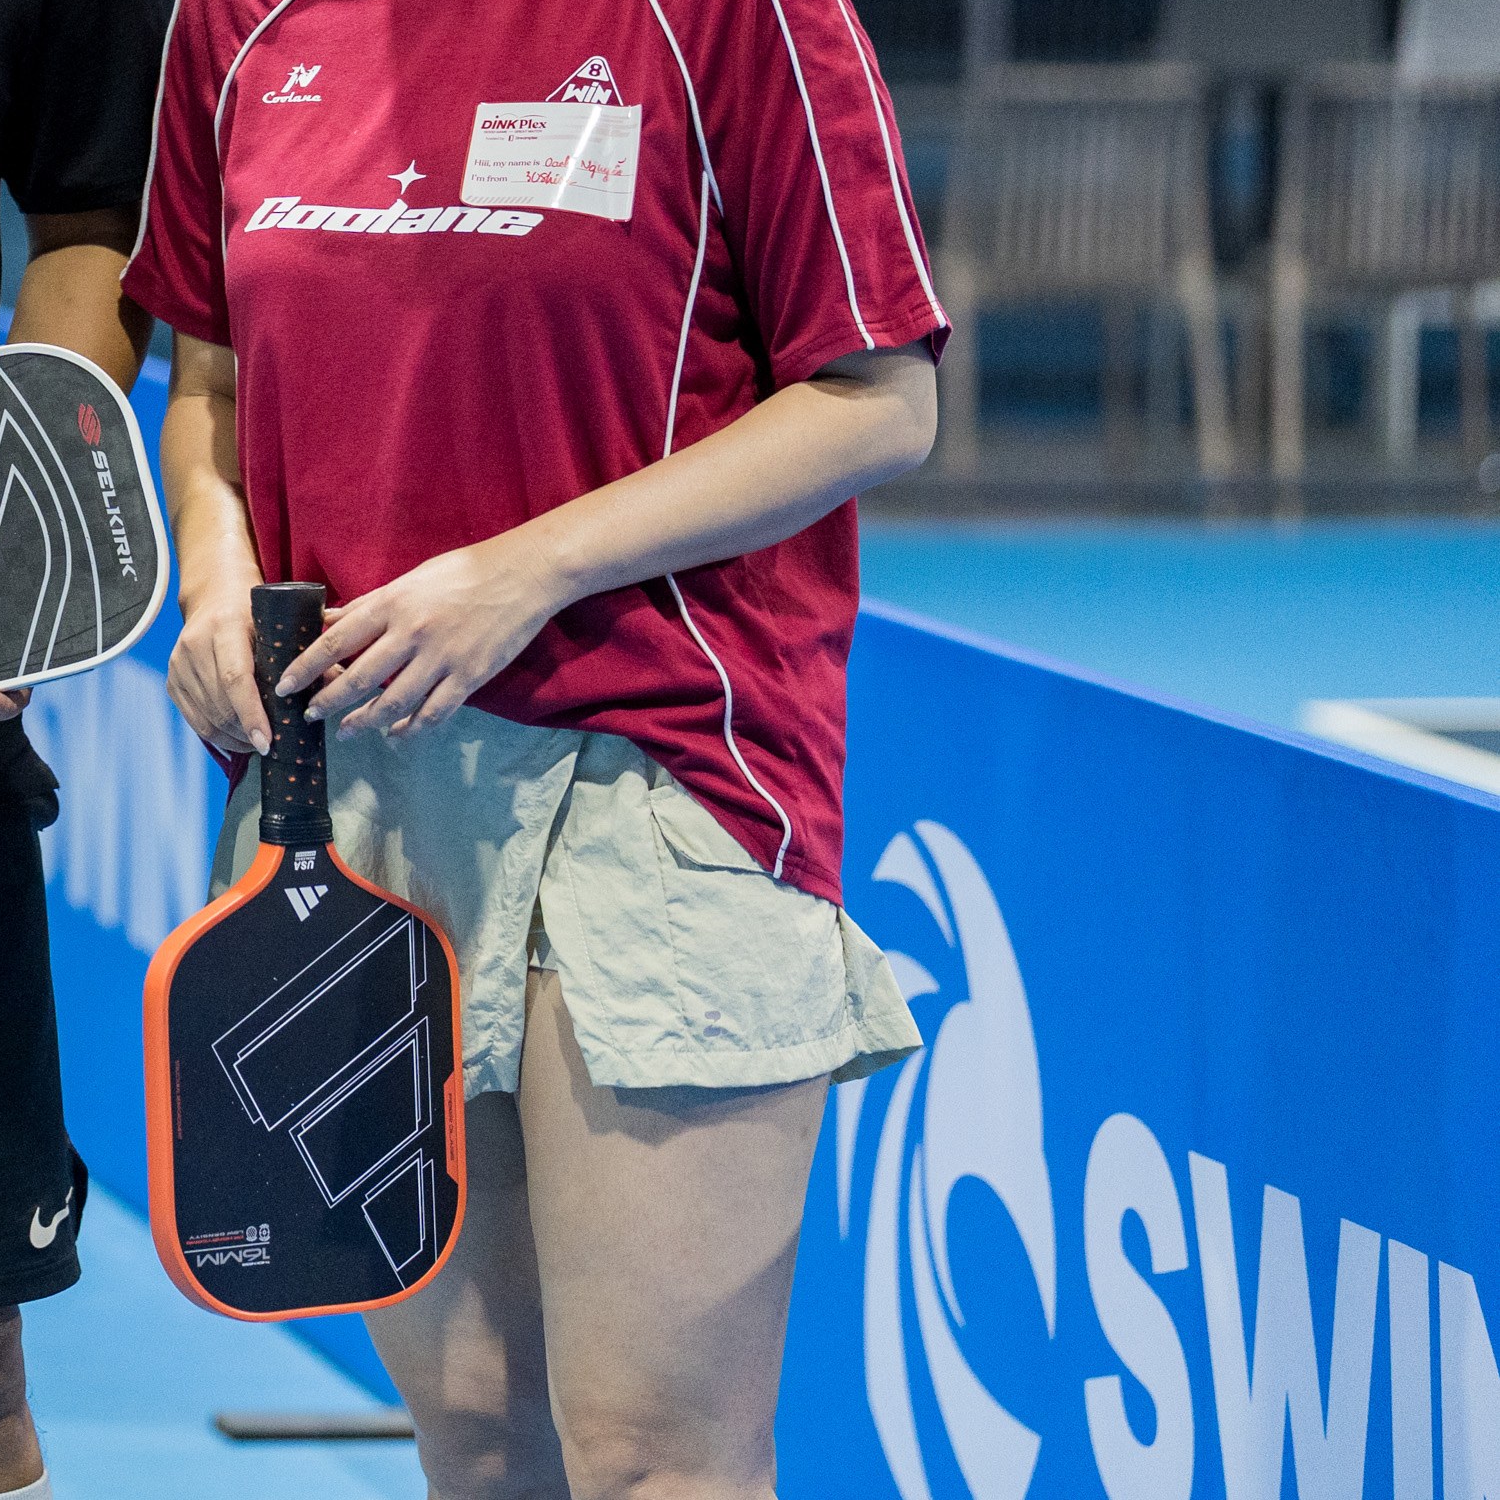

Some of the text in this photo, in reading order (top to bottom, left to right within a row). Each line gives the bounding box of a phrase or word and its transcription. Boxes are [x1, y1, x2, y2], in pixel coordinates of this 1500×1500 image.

[589, 63, 602, 77] 8
[262, 91, 322, 104] Coolane
[519, 119, 547, 129] Plex
[471, 174, 508, 182] I'm from
[243, 196, 544, 236] Coolane
[91, 450, 138, 578] SELKIRK
[293, 860, 315, 871] USA
[196, 1247, 271, 1268] 16MM
